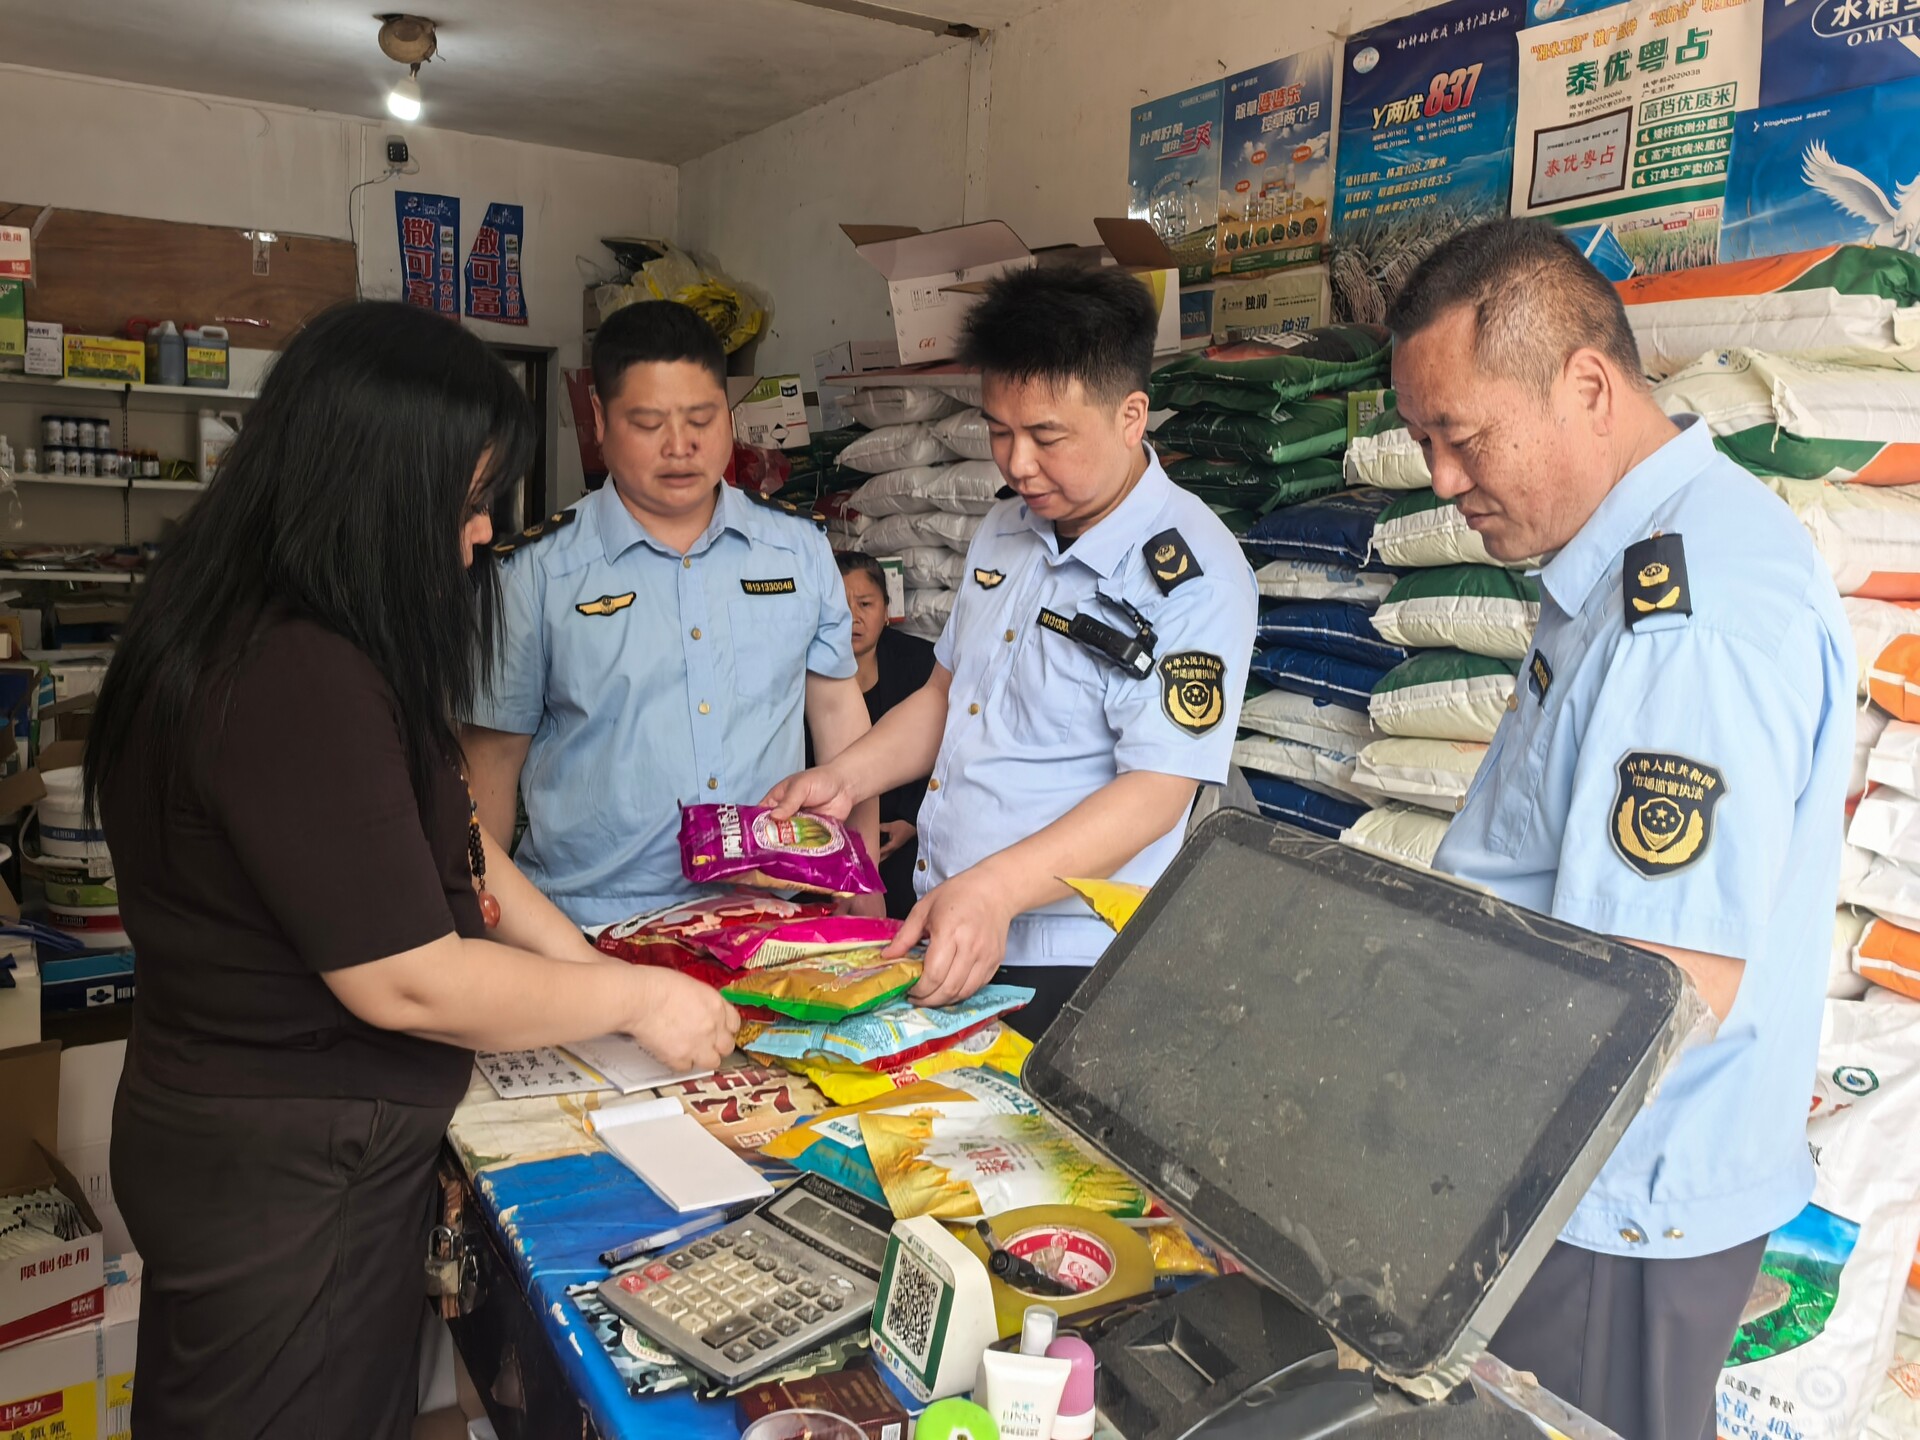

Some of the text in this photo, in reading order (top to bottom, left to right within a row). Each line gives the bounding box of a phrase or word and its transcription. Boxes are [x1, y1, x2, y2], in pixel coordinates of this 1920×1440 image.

[1847, 19, 1920, 46] OMNI
[1566, 28, 1712, 97] 泰优粤占
[1644, 88, 1731, 121] 高档优质米
[1653, 117, 1728, 139] 矮秆抗倒分蘖强
[1545, 145, 1616, 178] 泰优粤占
[1651, 138, 1727, 161] 高产抗病米质优
[1650, 160, 1725, 182] 订单生产卖价高
[0, 231, 22, 242] 使用
[1165, 656, 1220, 672] 中华人民共和国
[1627, 758, 1716, 790] 中华人民共和国
[1632, 773, 1704, 802] 市场监管执法
[20, 1247, 90, 1281] 限制使用
